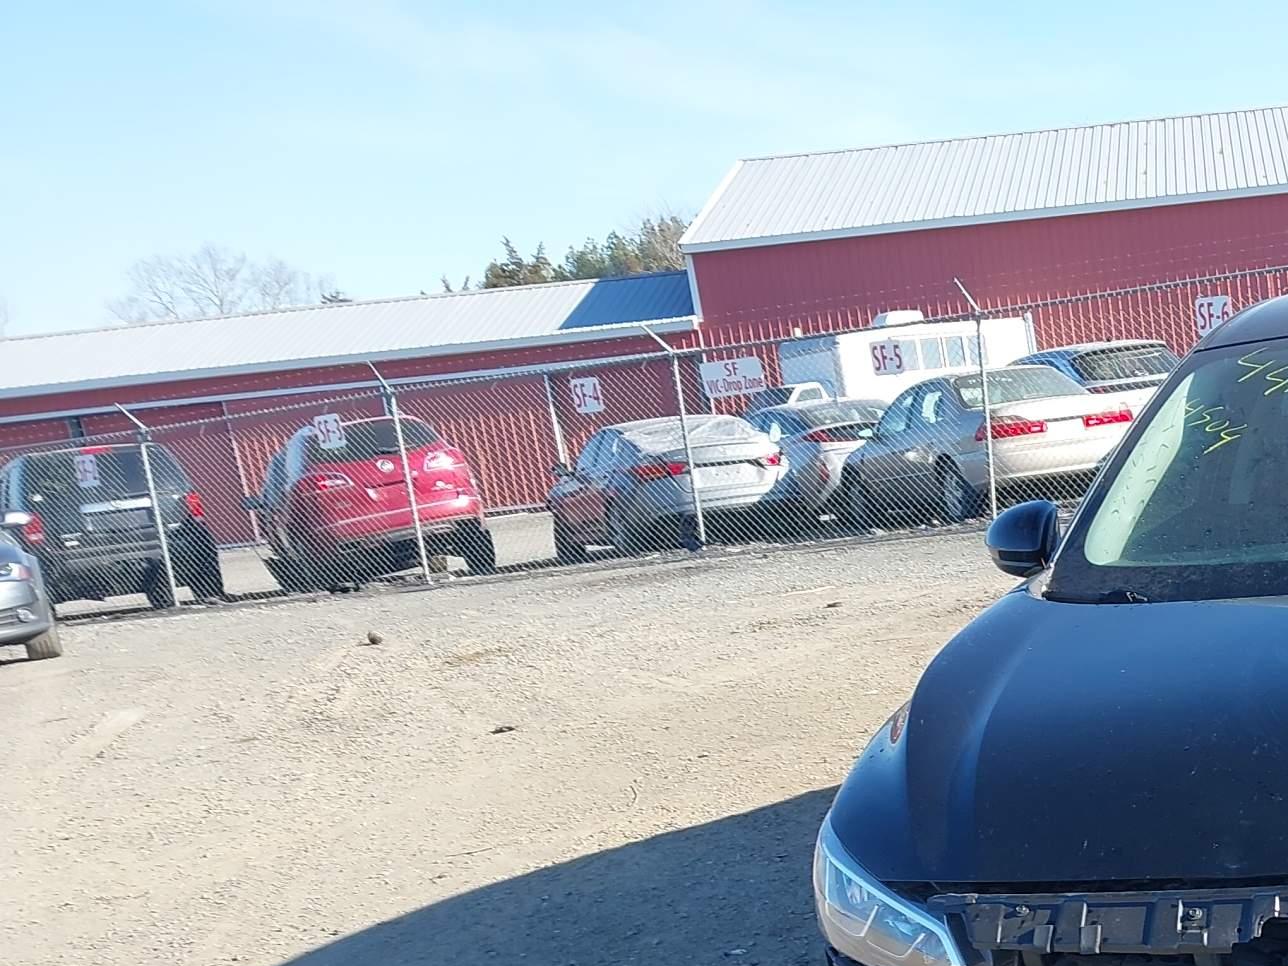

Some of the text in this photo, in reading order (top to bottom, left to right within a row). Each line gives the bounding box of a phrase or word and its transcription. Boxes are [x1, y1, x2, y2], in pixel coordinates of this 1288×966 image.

[723, 361, 739, 378] SF
[872, 344, 903, 371] SF-5
[573, 382, 601, 409] SF-4
[317, 418, 344, 444] SF-3
[1184, 398, 1249, 454] 4504
